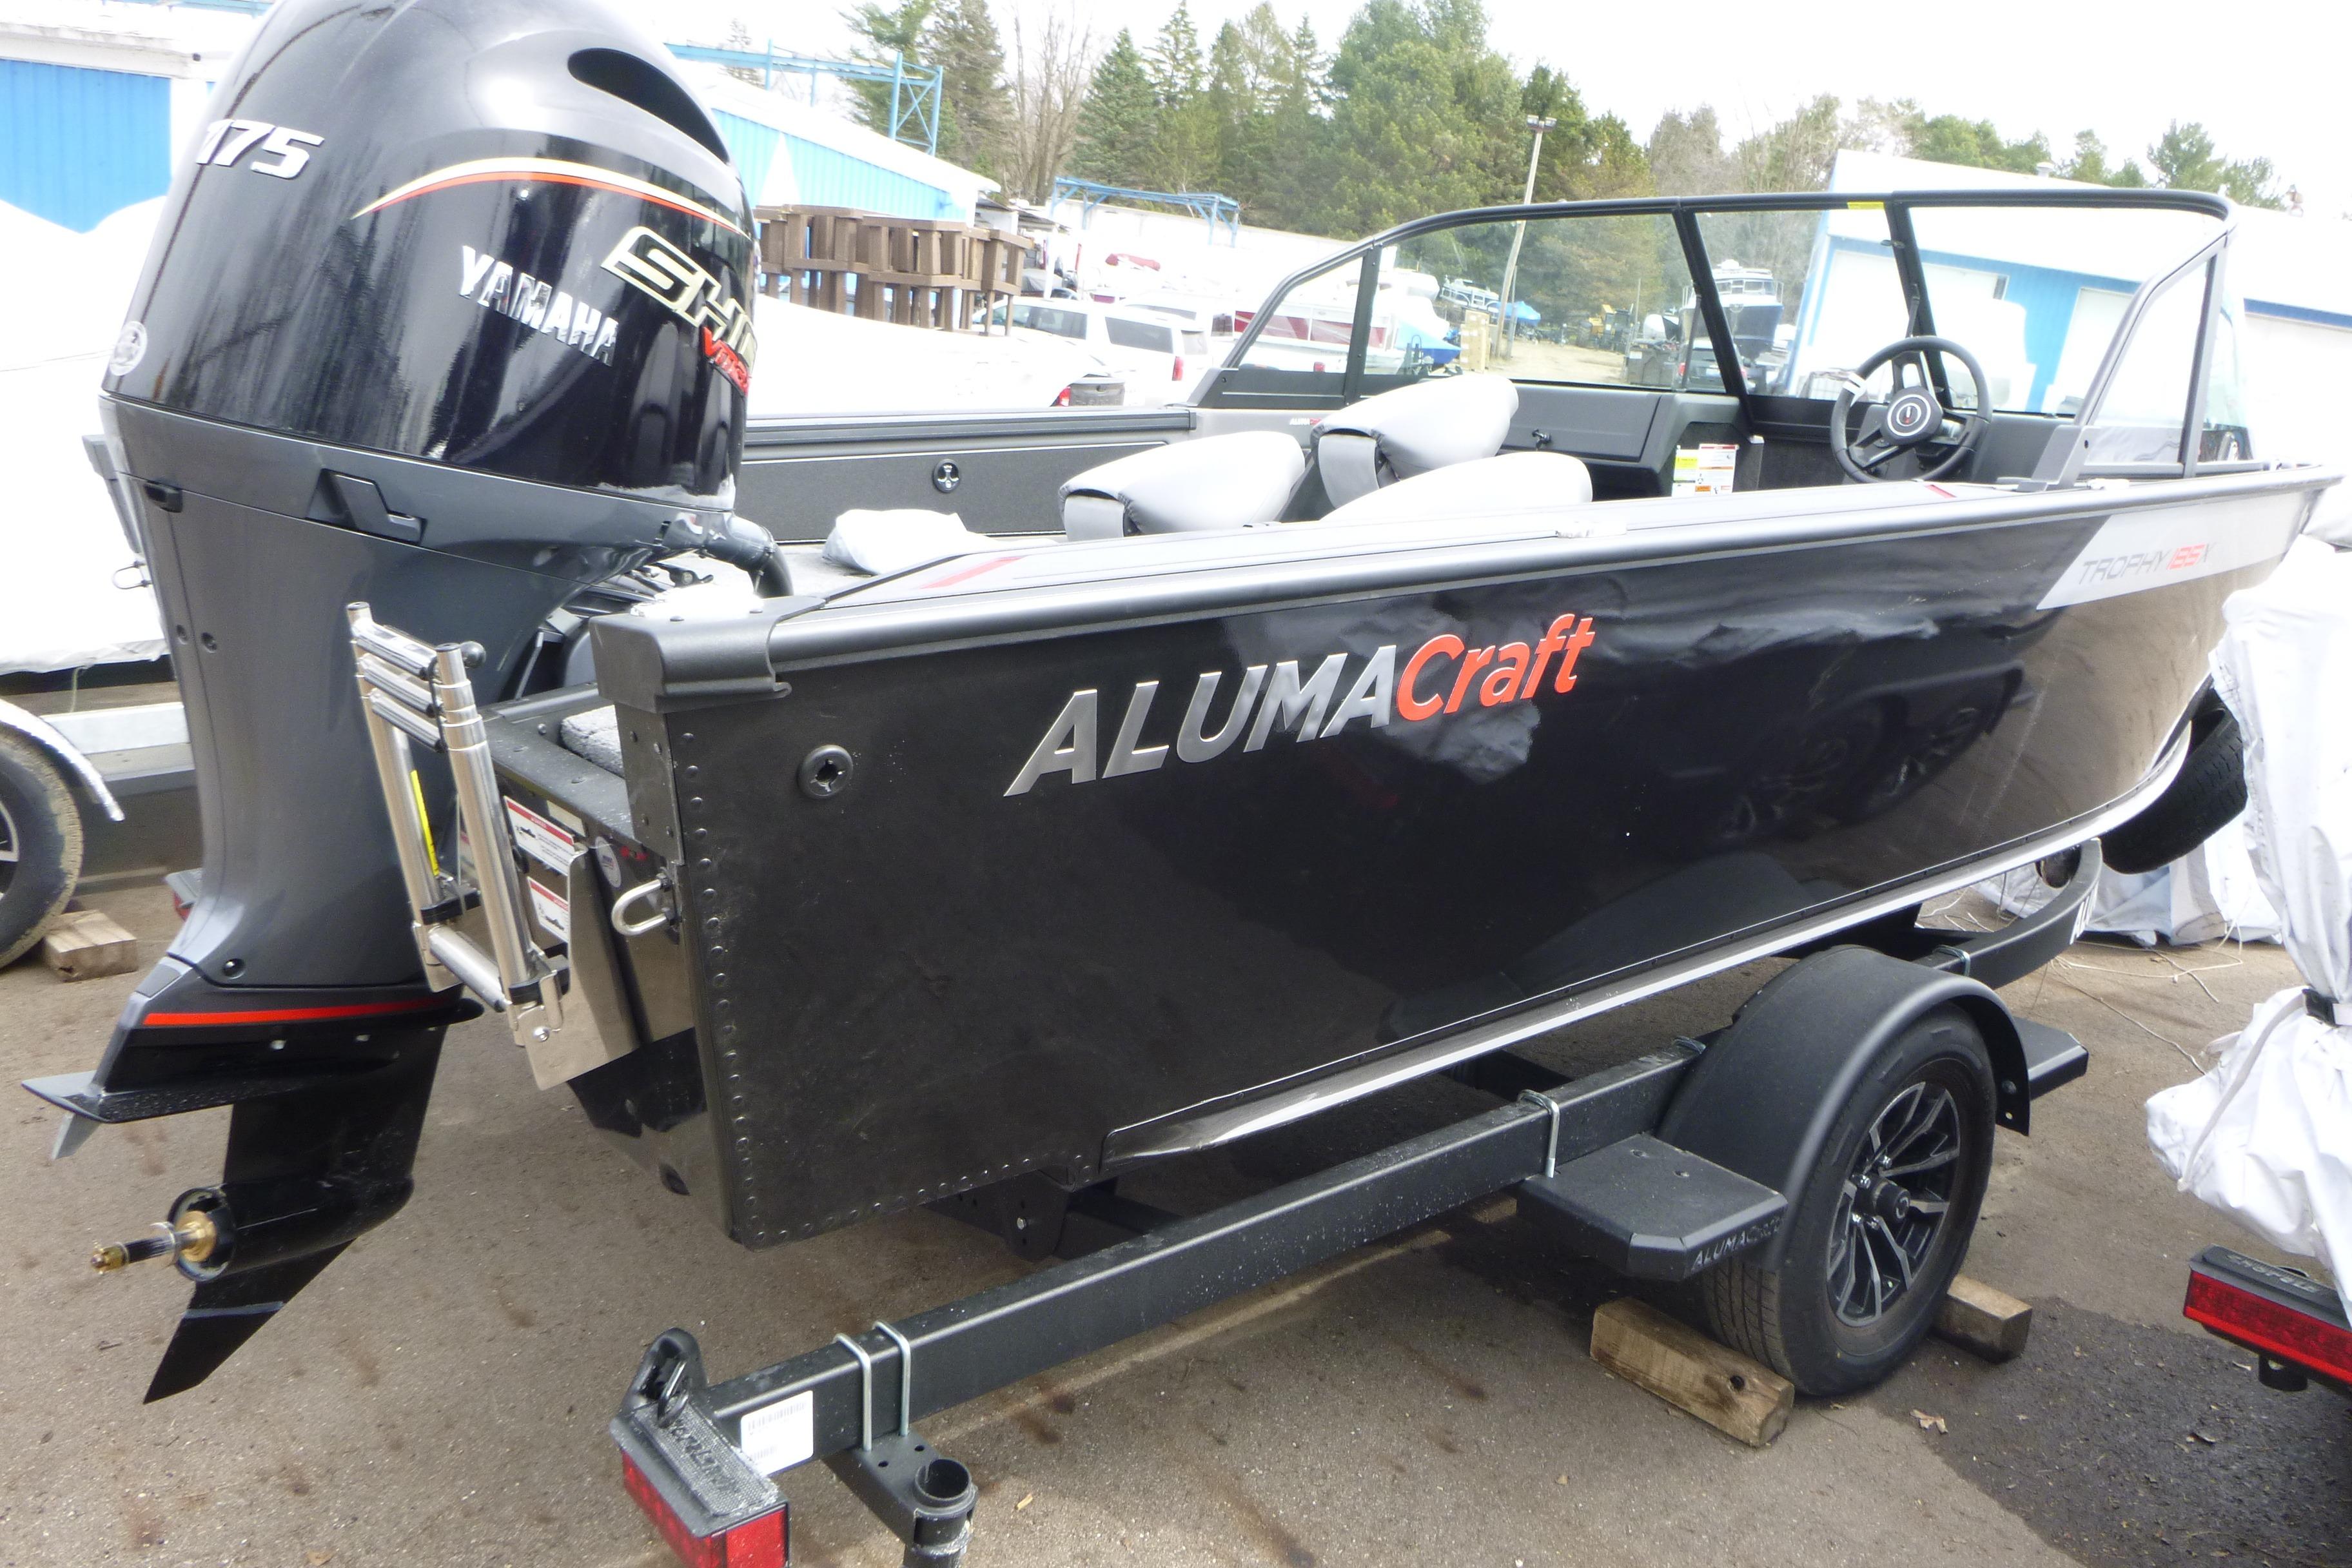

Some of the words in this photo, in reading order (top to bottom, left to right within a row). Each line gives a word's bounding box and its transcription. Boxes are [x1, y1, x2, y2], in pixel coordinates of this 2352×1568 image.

[195, 118, 325, 179] 175
[458, 245, 620, 367] YAMAHA
[2079, 548, 2172, 585] TROPHY
[1003, 613, 1596, 797] ALUMACraft
